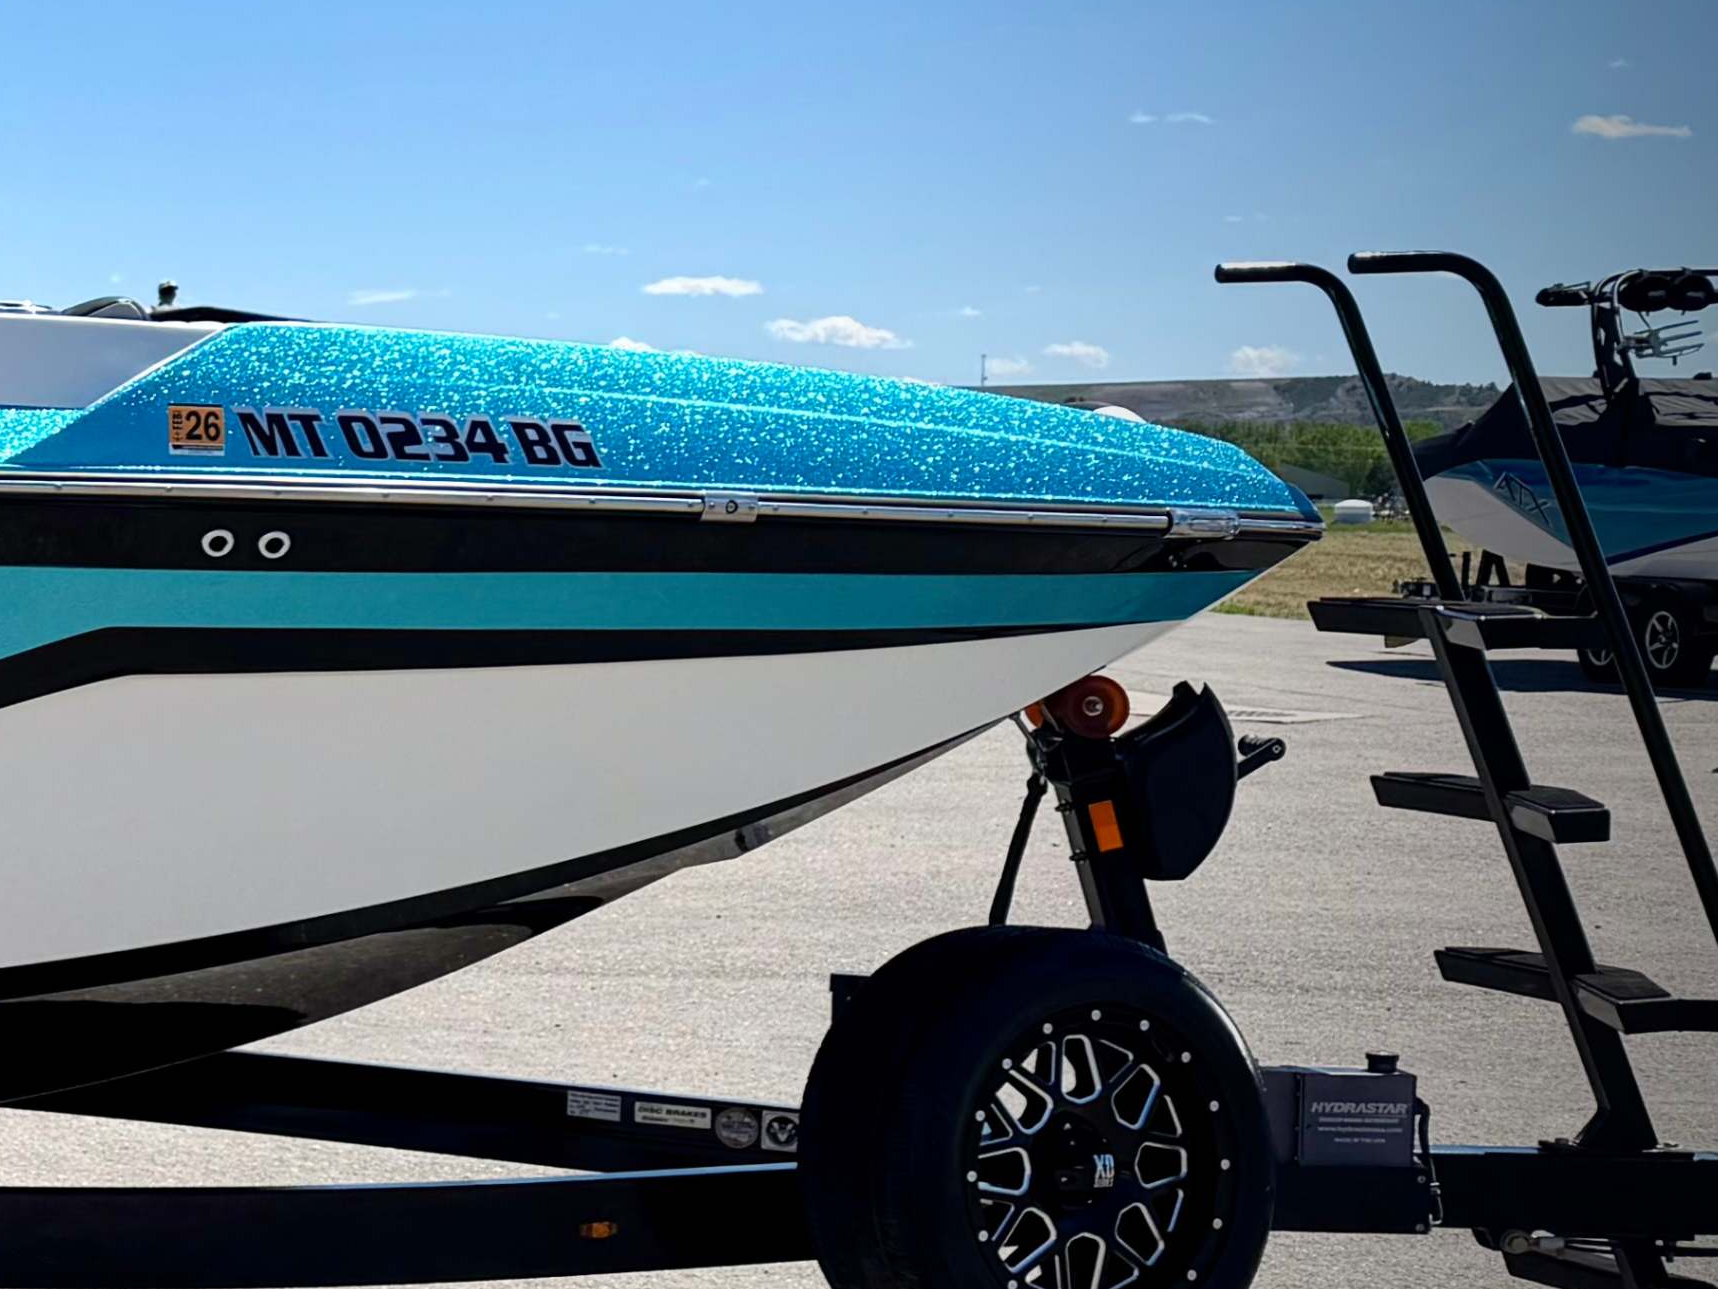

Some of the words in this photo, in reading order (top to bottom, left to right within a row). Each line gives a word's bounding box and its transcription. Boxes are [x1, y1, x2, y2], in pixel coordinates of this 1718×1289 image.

[185, 410, 221, 442] 26
[236, 408, 333, 459] MT
[337, 410, 510, 464] 0234
[510, 419, 603, 469] BG
[1310, 1101, 1408, 1114] HYDRASTAR
[1092, 1153, 1115, 1178] XD
